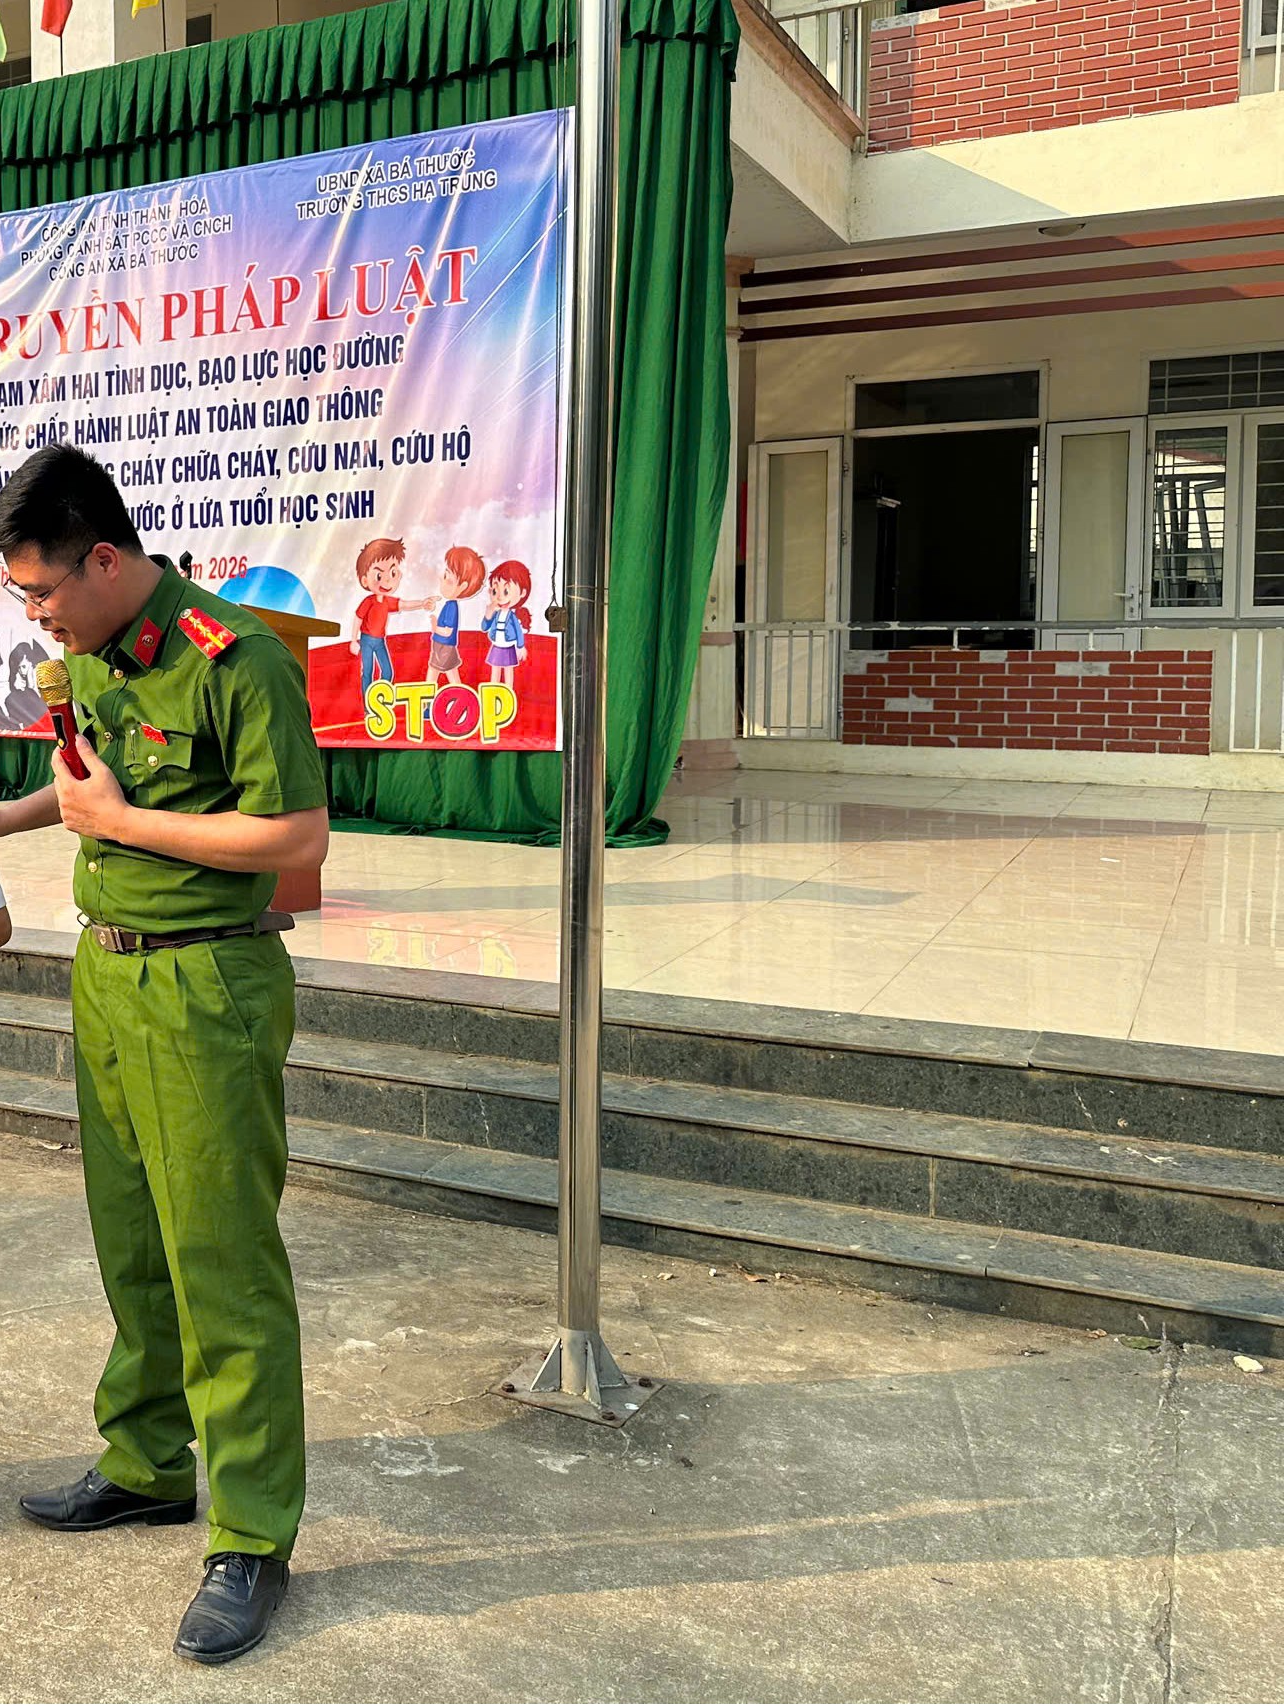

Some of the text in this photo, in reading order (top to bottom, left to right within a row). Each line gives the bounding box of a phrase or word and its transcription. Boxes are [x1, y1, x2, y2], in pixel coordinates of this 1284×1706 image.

[318, 147, 475, 193] UBND XÃ BÁ THƯỚC
[297, 171, 496, 219] TRƯỜNG THCS HẠ TRUNG
[41, 221, 76, 243] CÔNG
[79, 216, 97, 235] AN
[179, 197, 209, 217] HÓA
[105, 228, 130, 252] SÁT
[133, 228, 168, 247] PCCC
[172, 220, 190, 240] VÀ
[193, 216, 232, 237] CNCH
[49, 242, 199, 282] CÔNG AN XÃ BÁ THƯỚC
[159, 264, 301, 342] PHÁP
[315, 246, 478, 325] LUẬT
[29, 372, 66, 405] XÂM
[72, 372, 99, 405] HẠI
[105, 365, 145, 397] TÌNH
[150, 361, 192, 396] DỤC,
[198, 355, 236, 390] BẠO
[242, 348, 278, 386] LỰC
[285, 344, 326, 380] HỌC
[333, 332, 404, 371] ĐƯỜNG
[25, 412, 69, 449] CHẤP
[74, 413, 122, 445] HÀNH
[127, 406, 169, 444] LUẬT
[175, 407, 201, 437] AN
[206, 398, 256, 433] TOÀN
[263, 397, 310, 428] GIAO
[316, 385, 383, 423] THÔNG
[120, 453, 166, 487] CHÁY
[172, 449, 221, 483] CHỮA
[227, 444, 281, 479] CHÁY,
[288, 439, 327, 474] CỨU
[334, 439, 384, 475] NẠN,
[391, 429, 435, 466] CỨU
[441, 424, 471, 467] HỘ
[126, 500, 165, 532] ƯỚC
[171, 494, 184, 530] Ở
[189, 496, 224, 529] LỨA
[230, 487, 273, 526] TUỔI
[279, 493, 319, 529] HỌC
[325, 490, 375, 521] SINH
[208, 555, 248, 579] 2026
[367, 682, 516, 741] STOP
